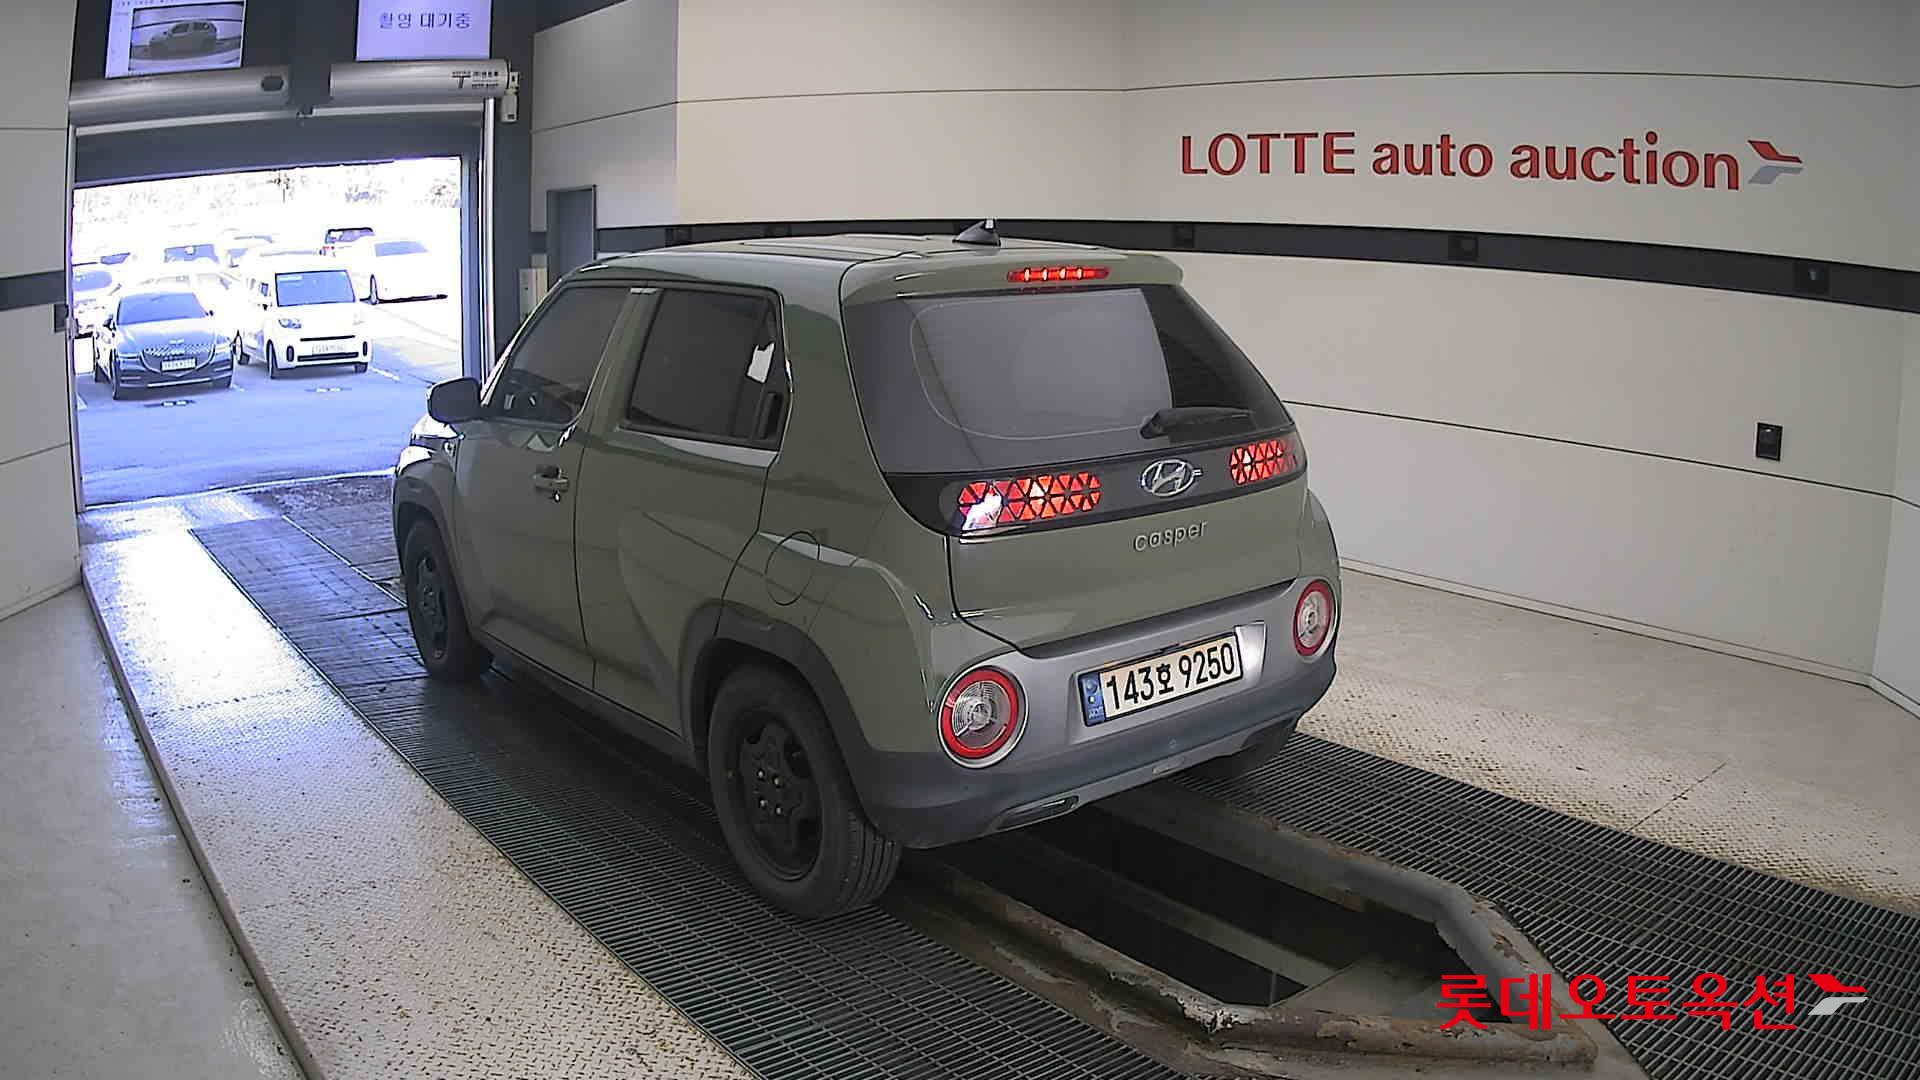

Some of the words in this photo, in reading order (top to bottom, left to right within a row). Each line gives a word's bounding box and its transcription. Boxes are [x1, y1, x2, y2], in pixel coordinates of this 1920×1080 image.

[420, 12, 471, 29] 대기중
[1180, 131, 1357, 175] LOTTE
[1371, 134, 1494, 177] auto
[1509, 131, 1741, 191] auction
[1133, 520, 1208, 552] casper
[1106, 662, 1174, 711] 143호
[1178, 642, 1236, 688] 9250
